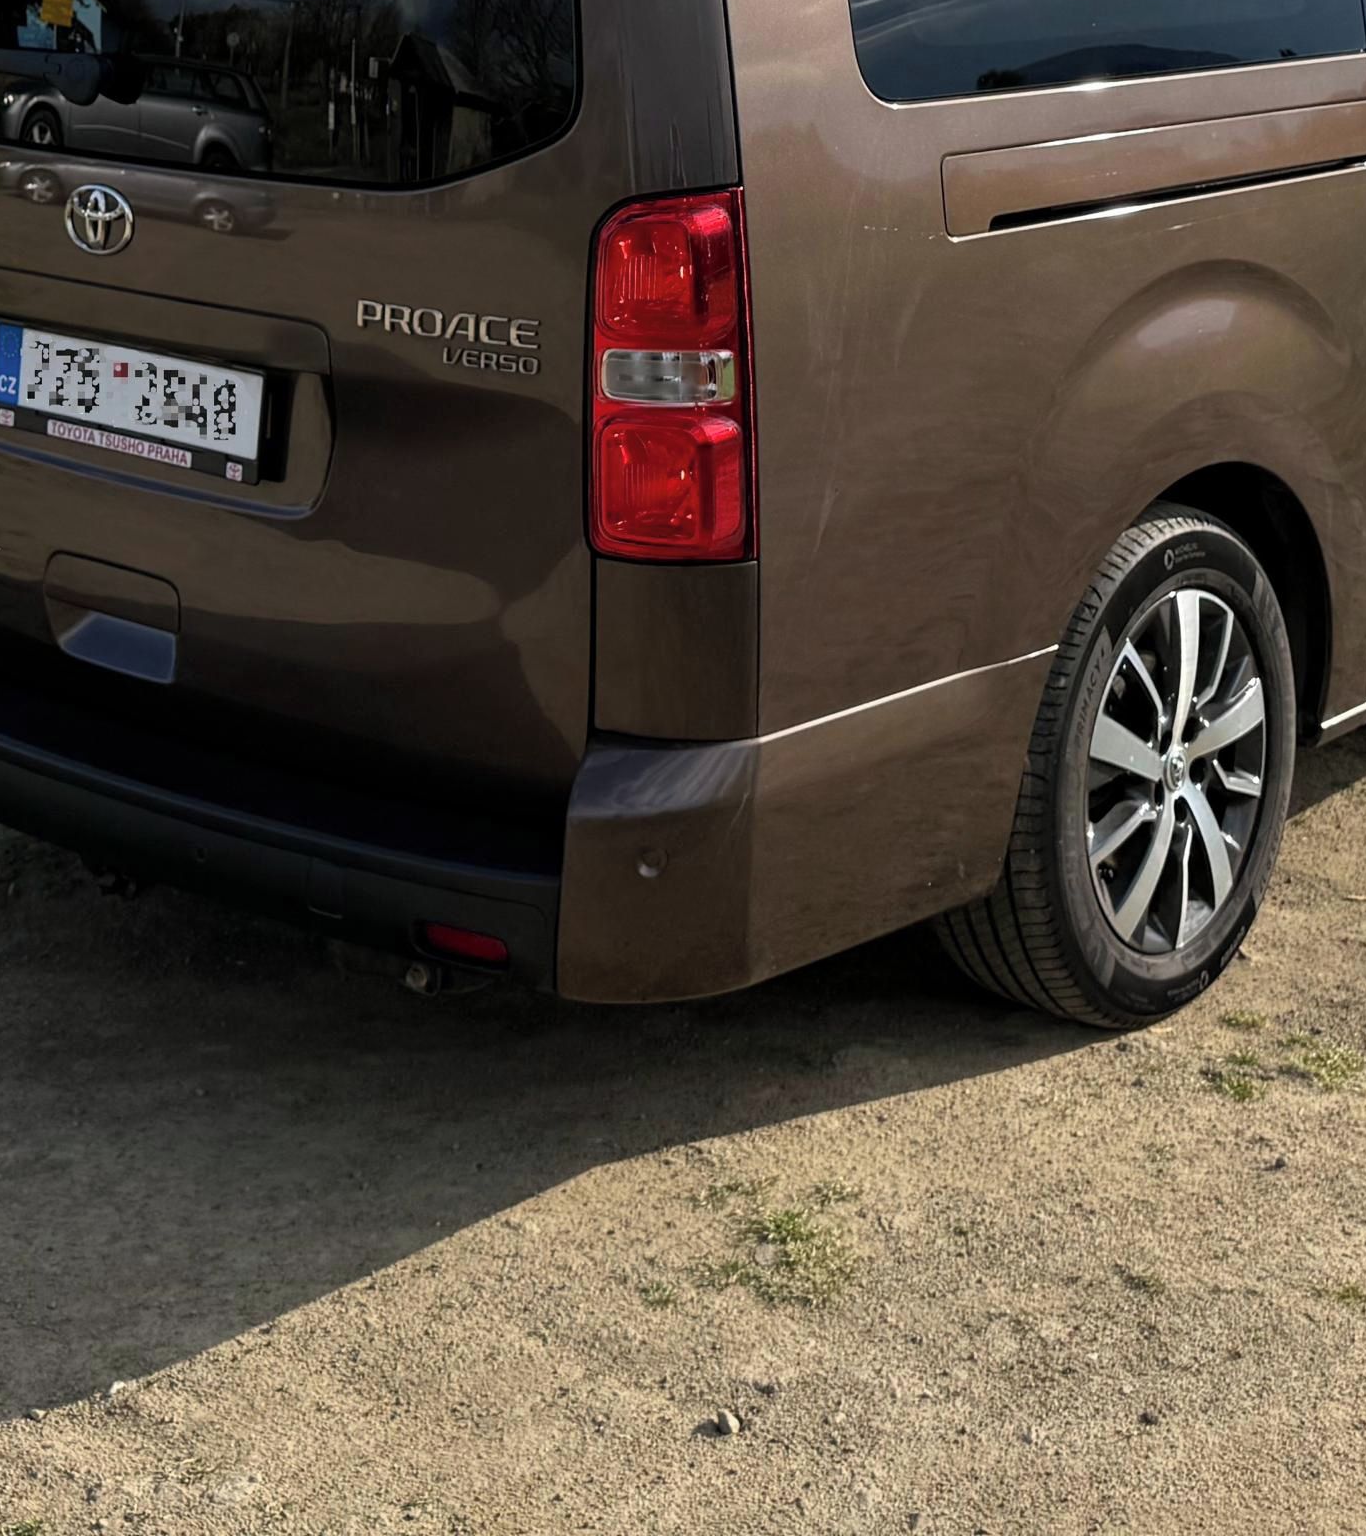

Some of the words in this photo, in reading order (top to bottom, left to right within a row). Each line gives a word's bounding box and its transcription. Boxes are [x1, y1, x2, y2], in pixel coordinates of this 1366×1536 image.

[356, 299, 540, 349] PROACE
[442, 347, 539, 375] VERSO
[51, 419, 95, 443] TOYOTA
[99, 432, 145, 454] TSUSHO
[147, 444, 188, 465] PRAHA
